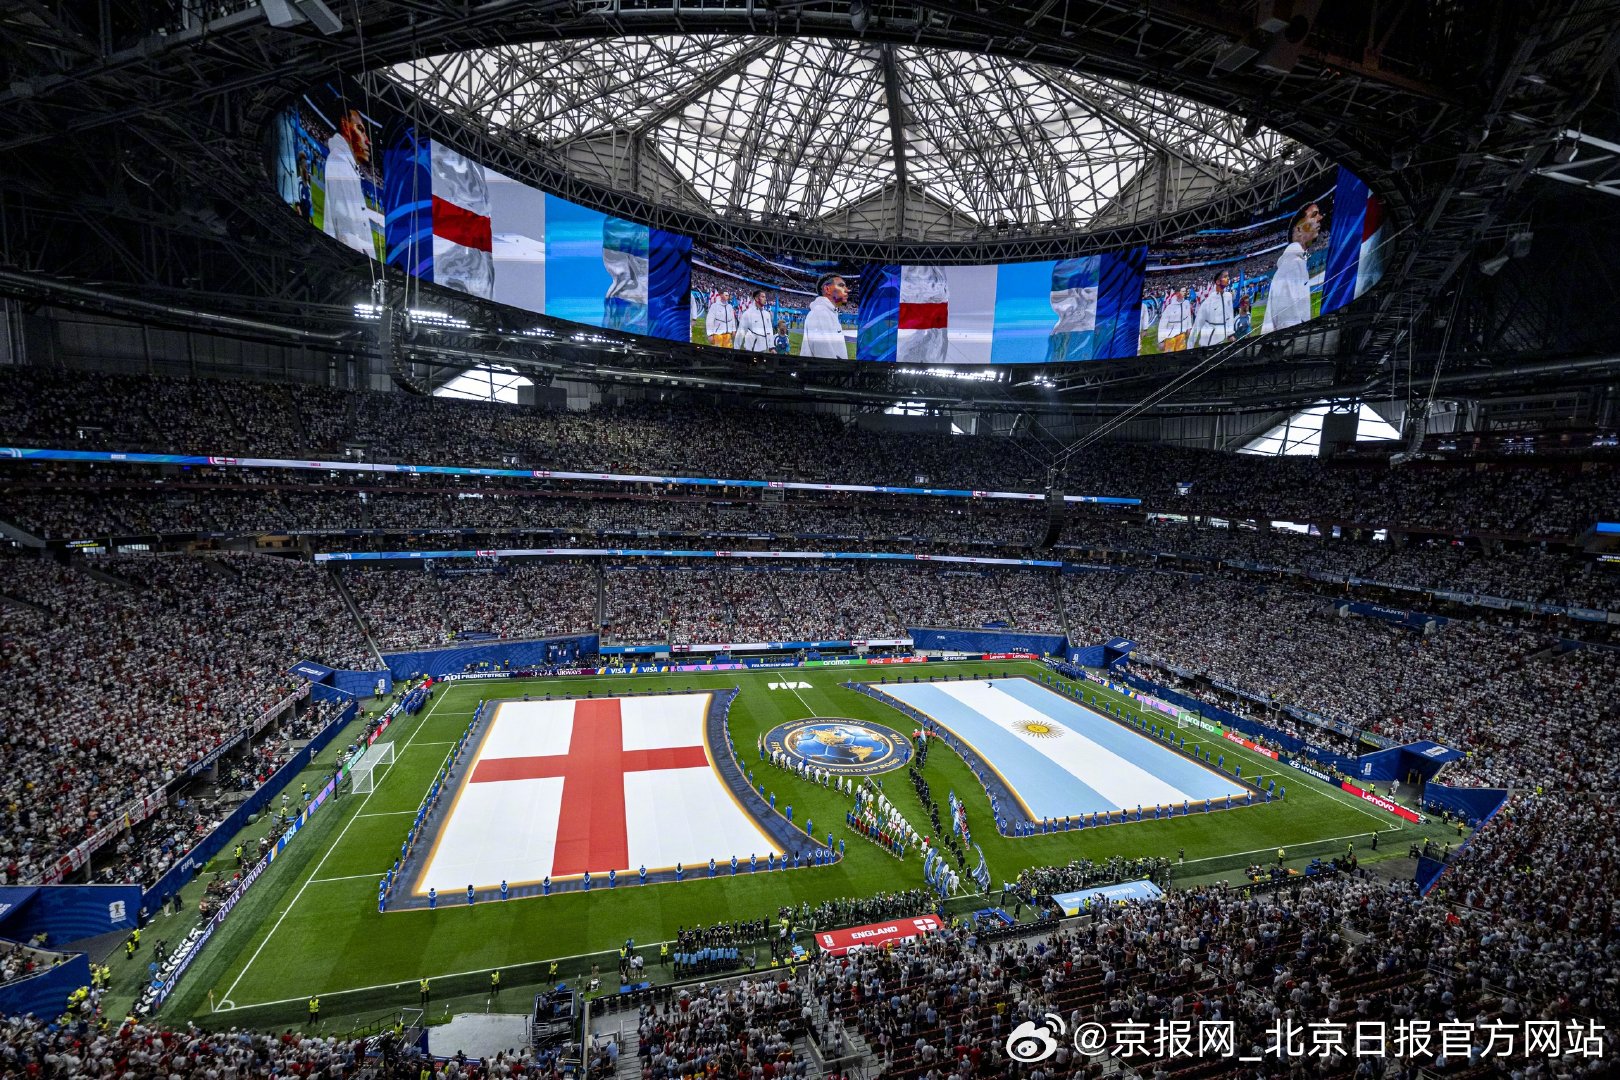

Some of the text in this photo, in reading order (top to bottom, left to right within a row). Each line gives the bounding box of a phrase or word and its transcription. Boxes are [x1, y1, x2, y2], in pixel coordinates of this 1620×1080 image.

[443, 674, 460, 682] ADI
[1113, 683, 1125, 694] VISA
[1185, 715, 1214, 732] aramco
[1306, 745, 1319, 755] FIFA
[191, 763, 203, 776] FIFA
[203, 749, 219, 768] WORLD
[219, 744, 229, 755] CUP
[1301, 764, 1330, 782] HYUNDAI
[1361, 788, 1395, 812] Lenovo
[282, 823, 297, 845] VISA
[181, 857, 194, 872] FIFA
[218, 859, 267, 922] QATAR AIRWAYS
[851, 926, 898, 940] ENGLAND
[160, 975, 175, 1003] ADI
